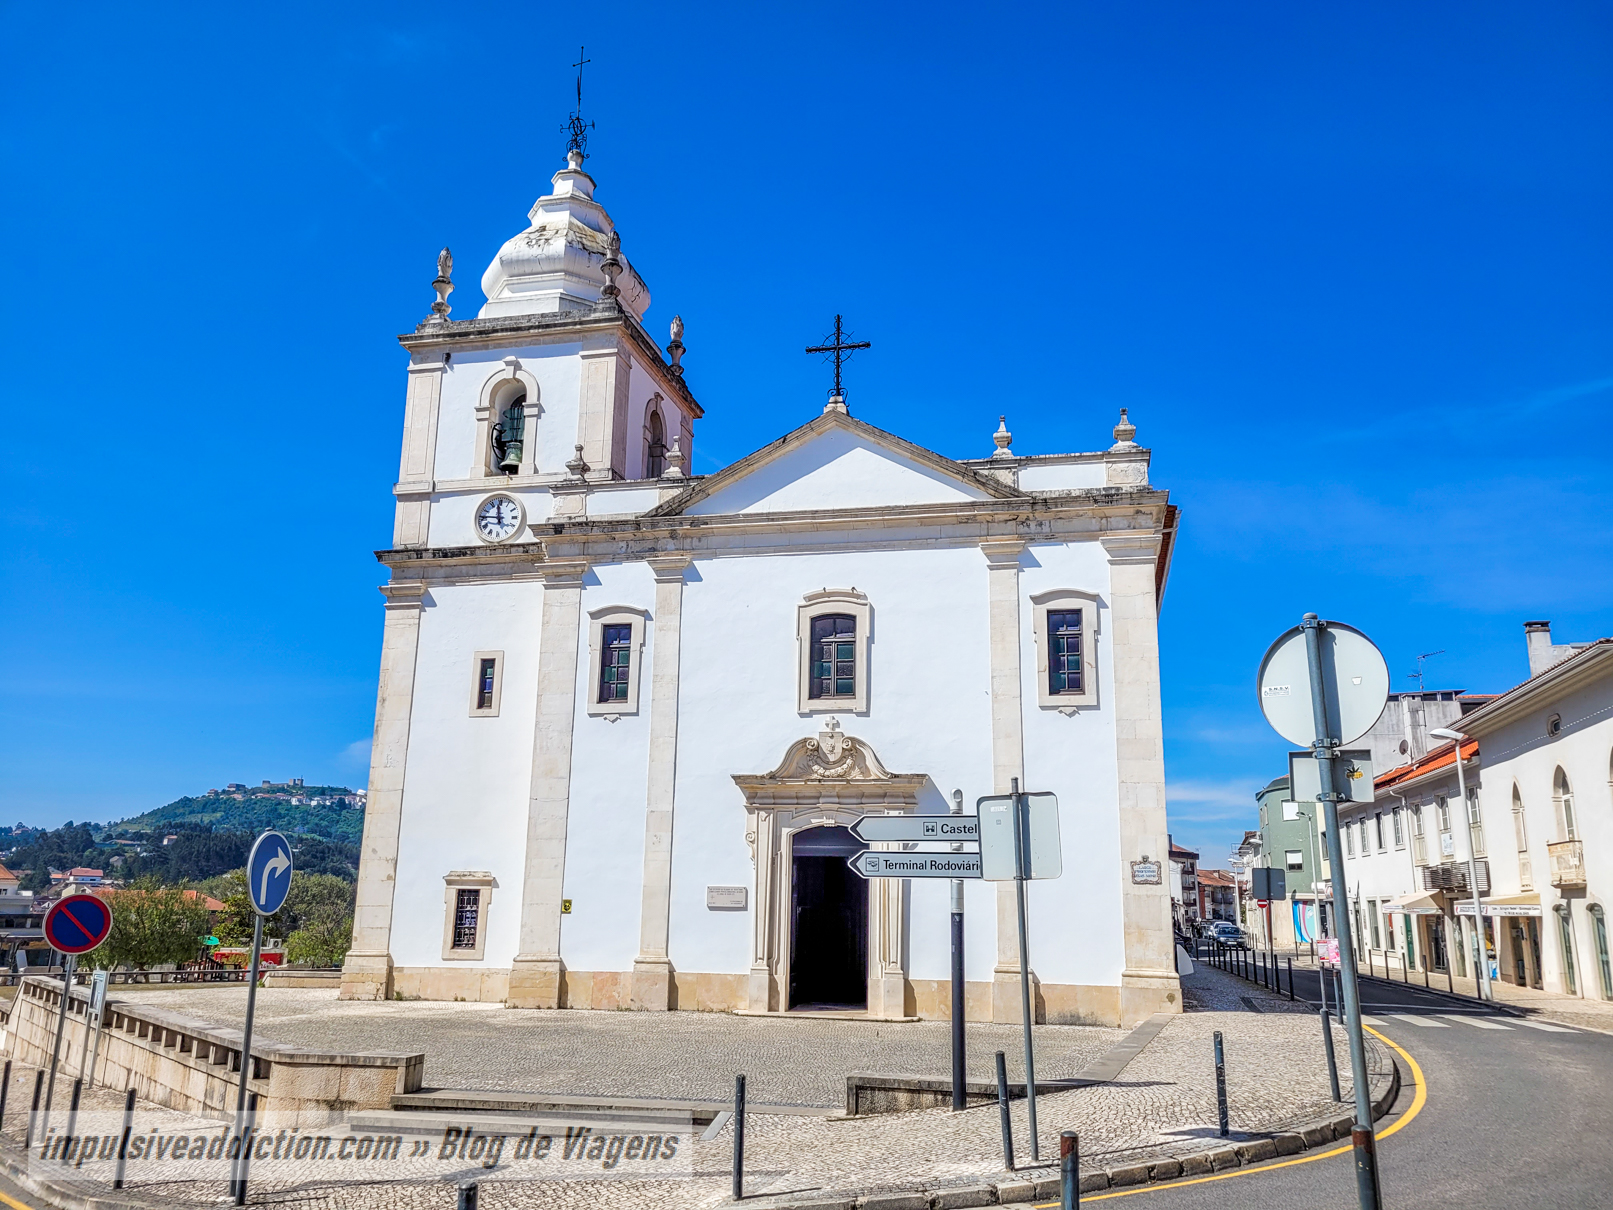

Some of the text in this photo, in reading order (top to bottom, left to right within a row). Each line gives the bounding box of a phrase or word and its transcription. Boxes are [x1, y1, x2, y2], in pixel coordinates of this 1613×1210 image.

[940, 823, 978, 834] Castel
[883, 860, 980, 871] Terminal Rodoviári
